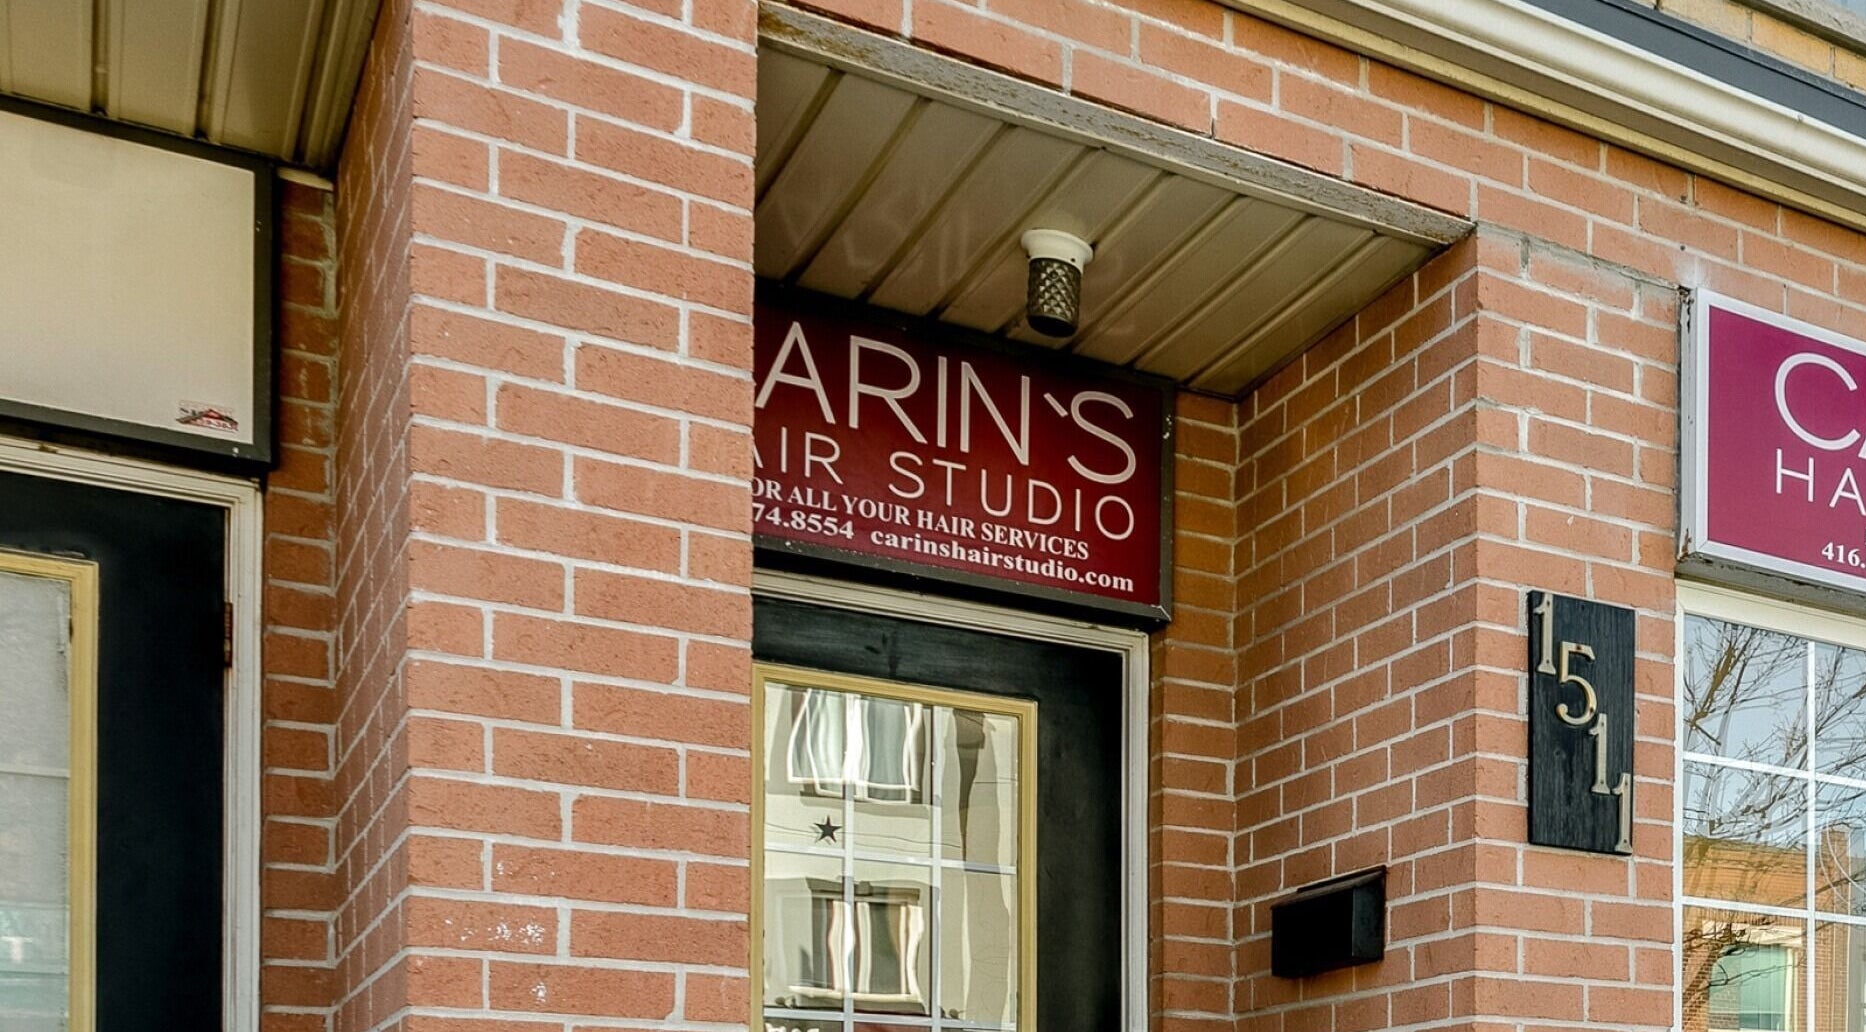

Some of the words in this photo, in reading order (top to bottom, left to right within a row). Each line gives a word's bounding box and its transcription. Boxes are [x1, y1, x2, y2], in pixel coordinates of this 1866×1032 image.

[755, 321, 1137, 485] ARIN'S
[752, 476, 783, 502] OR
[787, 486, 837, 511] ALL
[841, 494, 911, 526] YOUR
[917, 509, 976, 539] HAIR
[981, 523, 1090, 560] SERVICES
[889, 451, 1135, 541] STUDIO
[752, 502, 855, 539] 74.8554
[870, 530, 1135, 592] carinshairstudio.com
[1533, 592, 1633, 853] 1511
